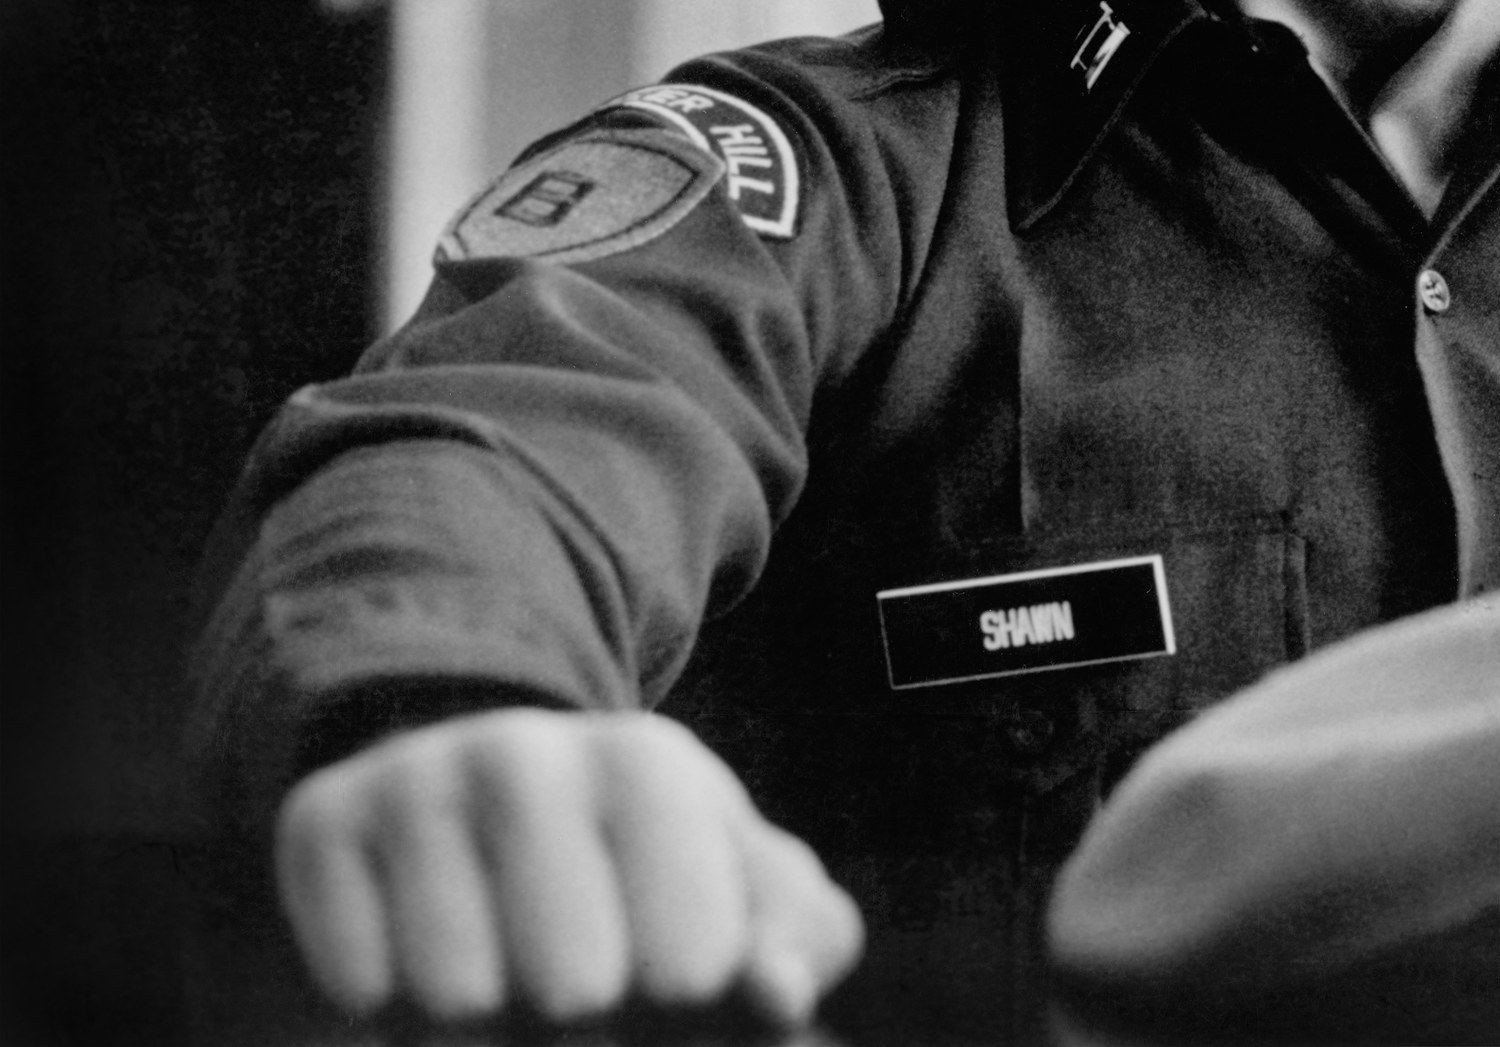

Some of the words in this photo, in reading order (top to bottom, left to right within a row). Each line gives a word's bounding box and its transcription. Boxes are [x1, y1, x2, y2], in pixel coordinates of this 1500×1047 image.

[628, 89, 715, 113] ER
[709, 124, 775, 200] HILL
[979, 600, 1075, 650] SHAWN
